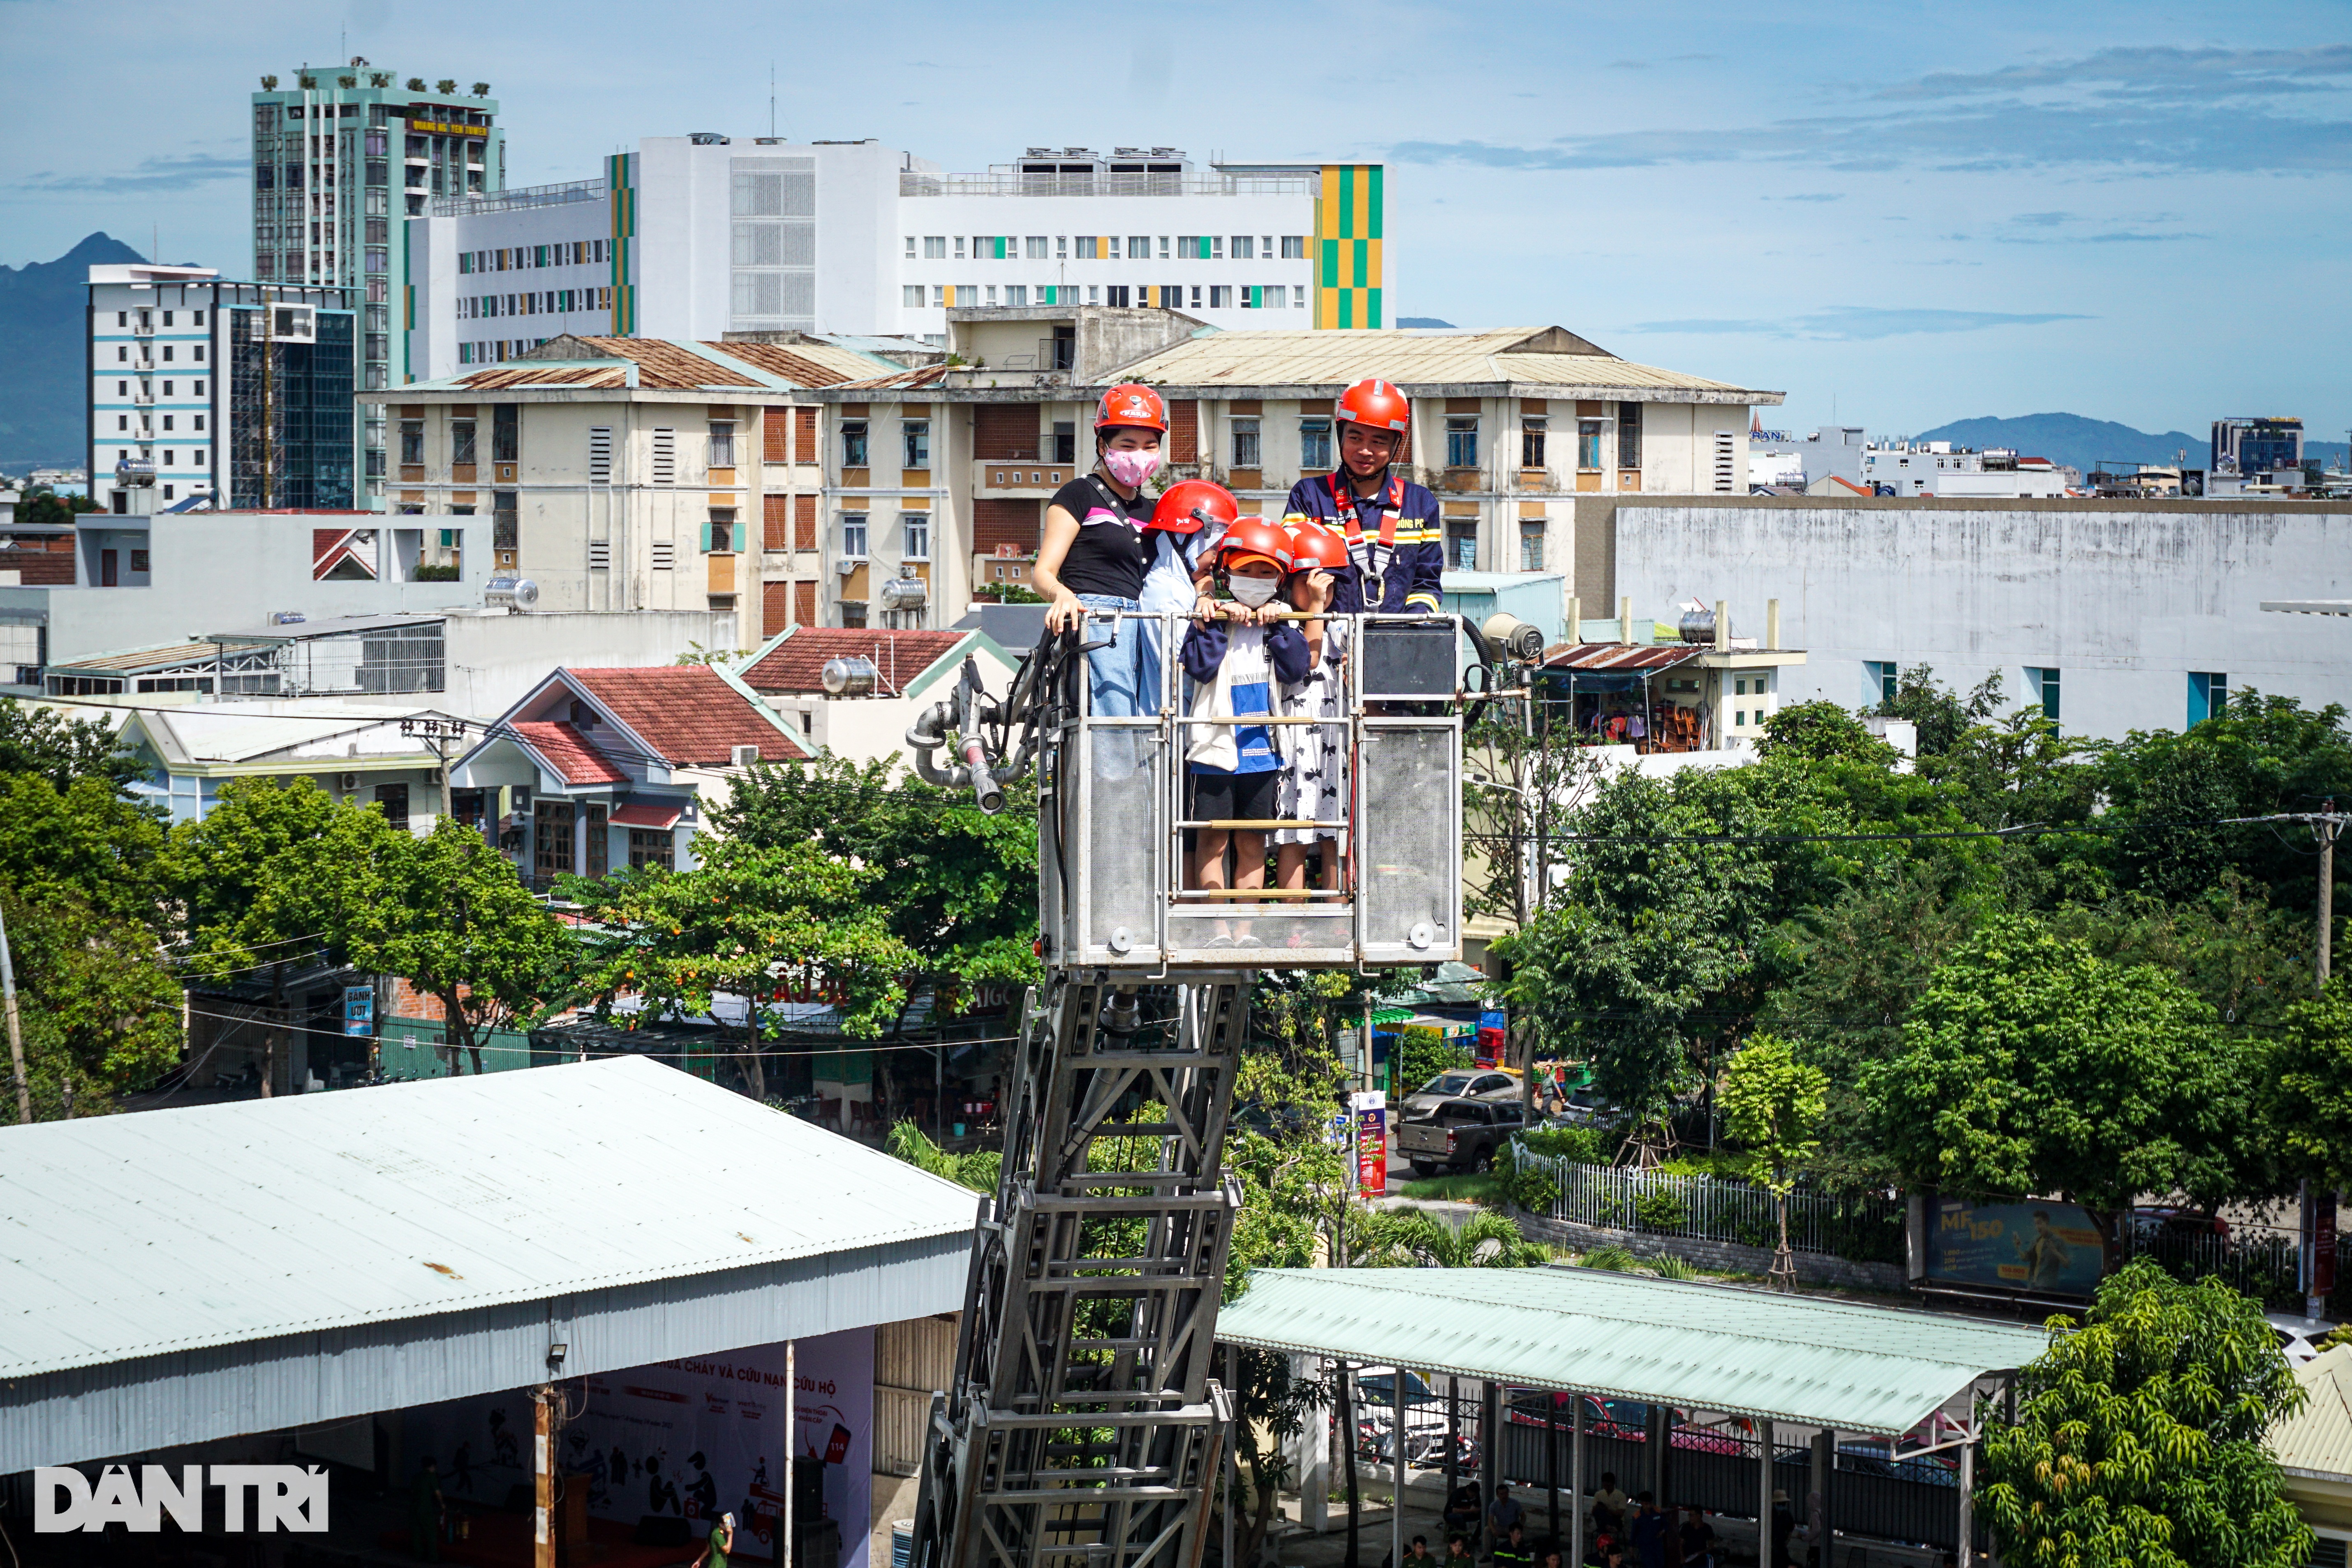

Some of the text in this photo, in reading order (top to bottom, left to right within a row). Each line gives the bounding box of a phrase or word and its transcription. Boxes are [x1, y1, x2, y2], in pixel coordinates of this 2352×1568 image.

[347, 990, 370, 1002] BÁNH
[351, 1004, 366, 1017] ƯỚT
[685, 1360, 715, 1376] CHÁY
[719, 1363, 734, 1379] VÀ
[738, 1367, 761, 1383] CỨU
[819, 1379, 836, 1398] HỘ
[830, 1442, 845, 1452] 114
